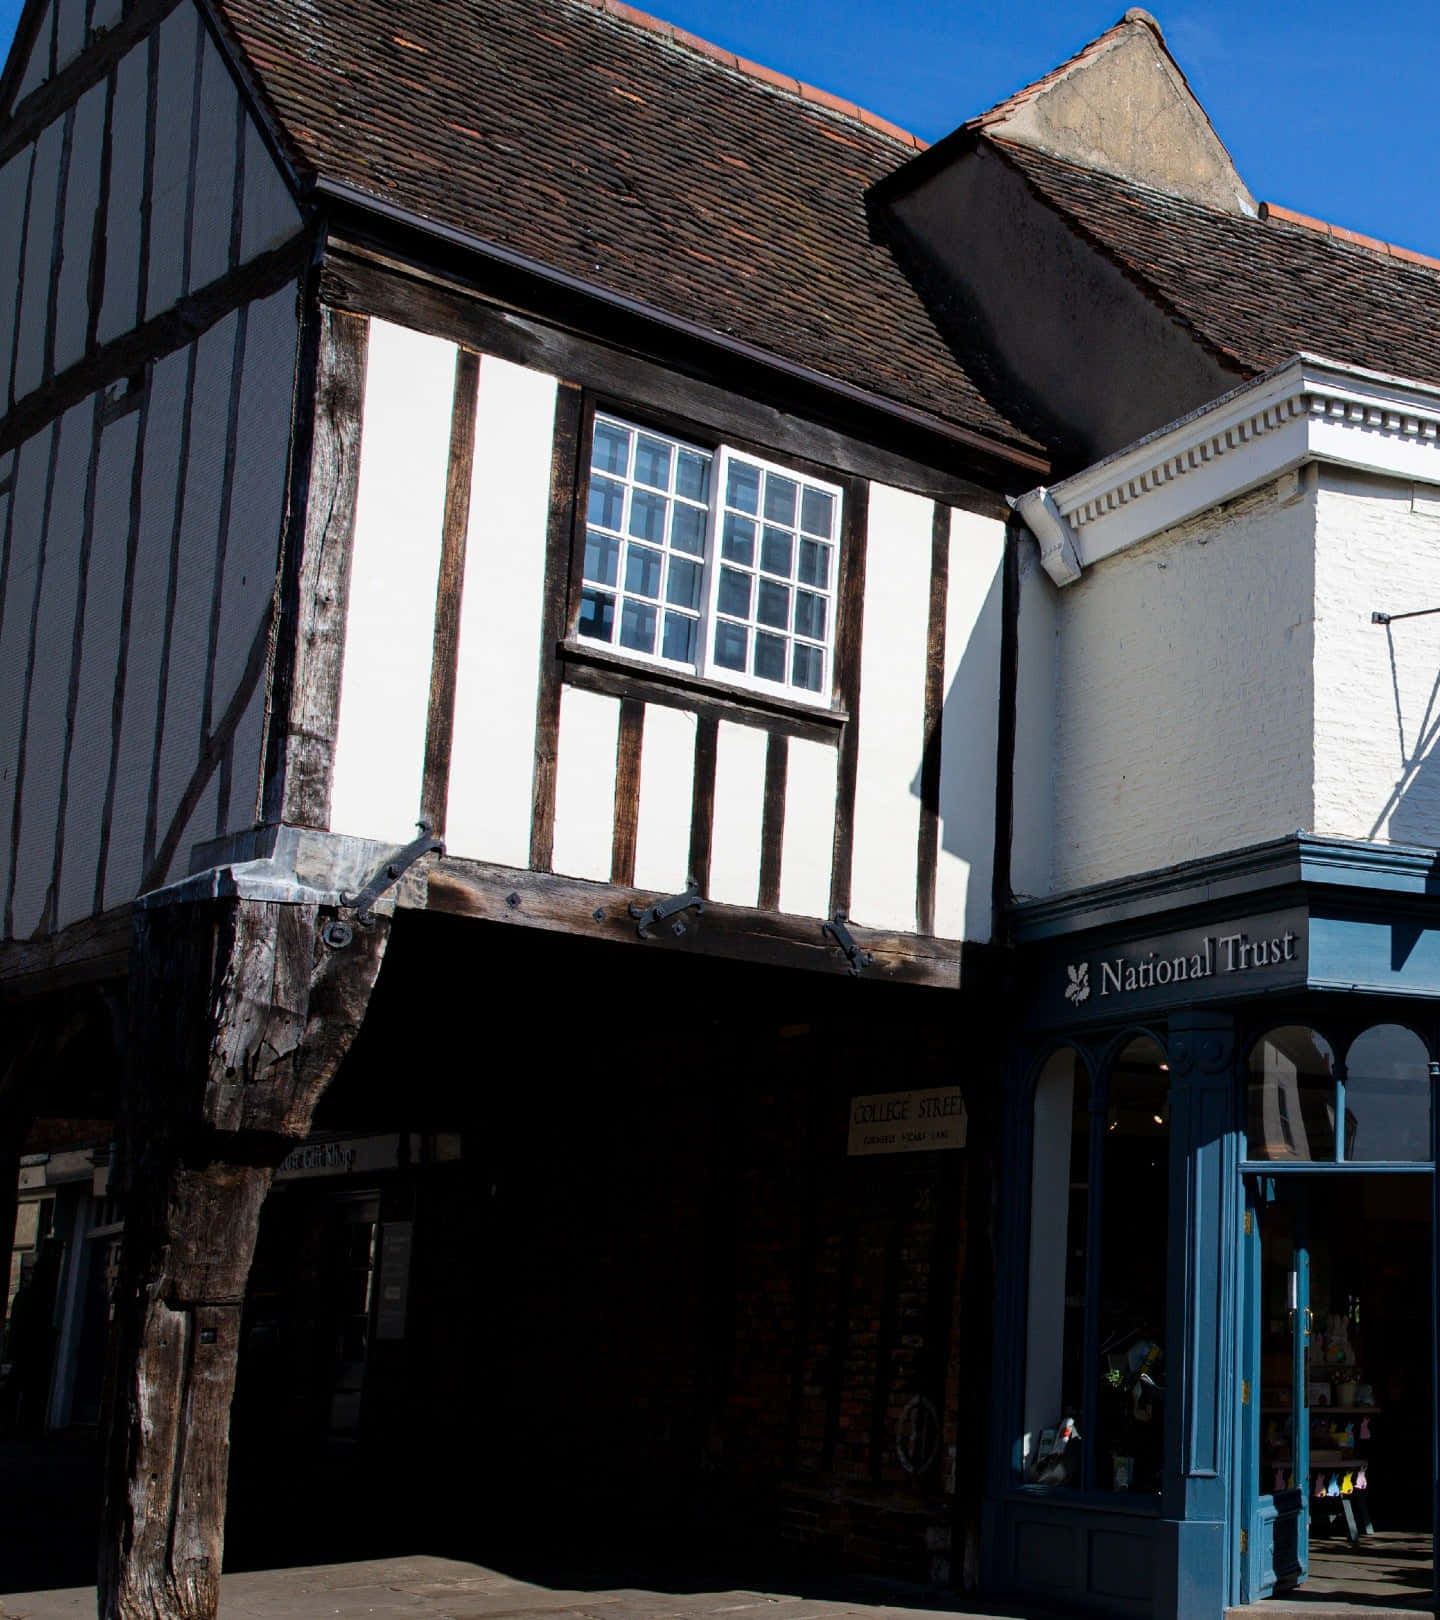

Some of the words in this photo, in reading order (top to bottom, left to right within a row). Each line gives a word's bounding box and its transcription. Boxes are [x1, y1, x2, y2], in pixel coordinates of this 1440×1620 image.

[1100, 936, 1213, 996] National
[1218, 930, 1296, 972] Trust
[854, 1100, 912, 1125] COLLEGE
